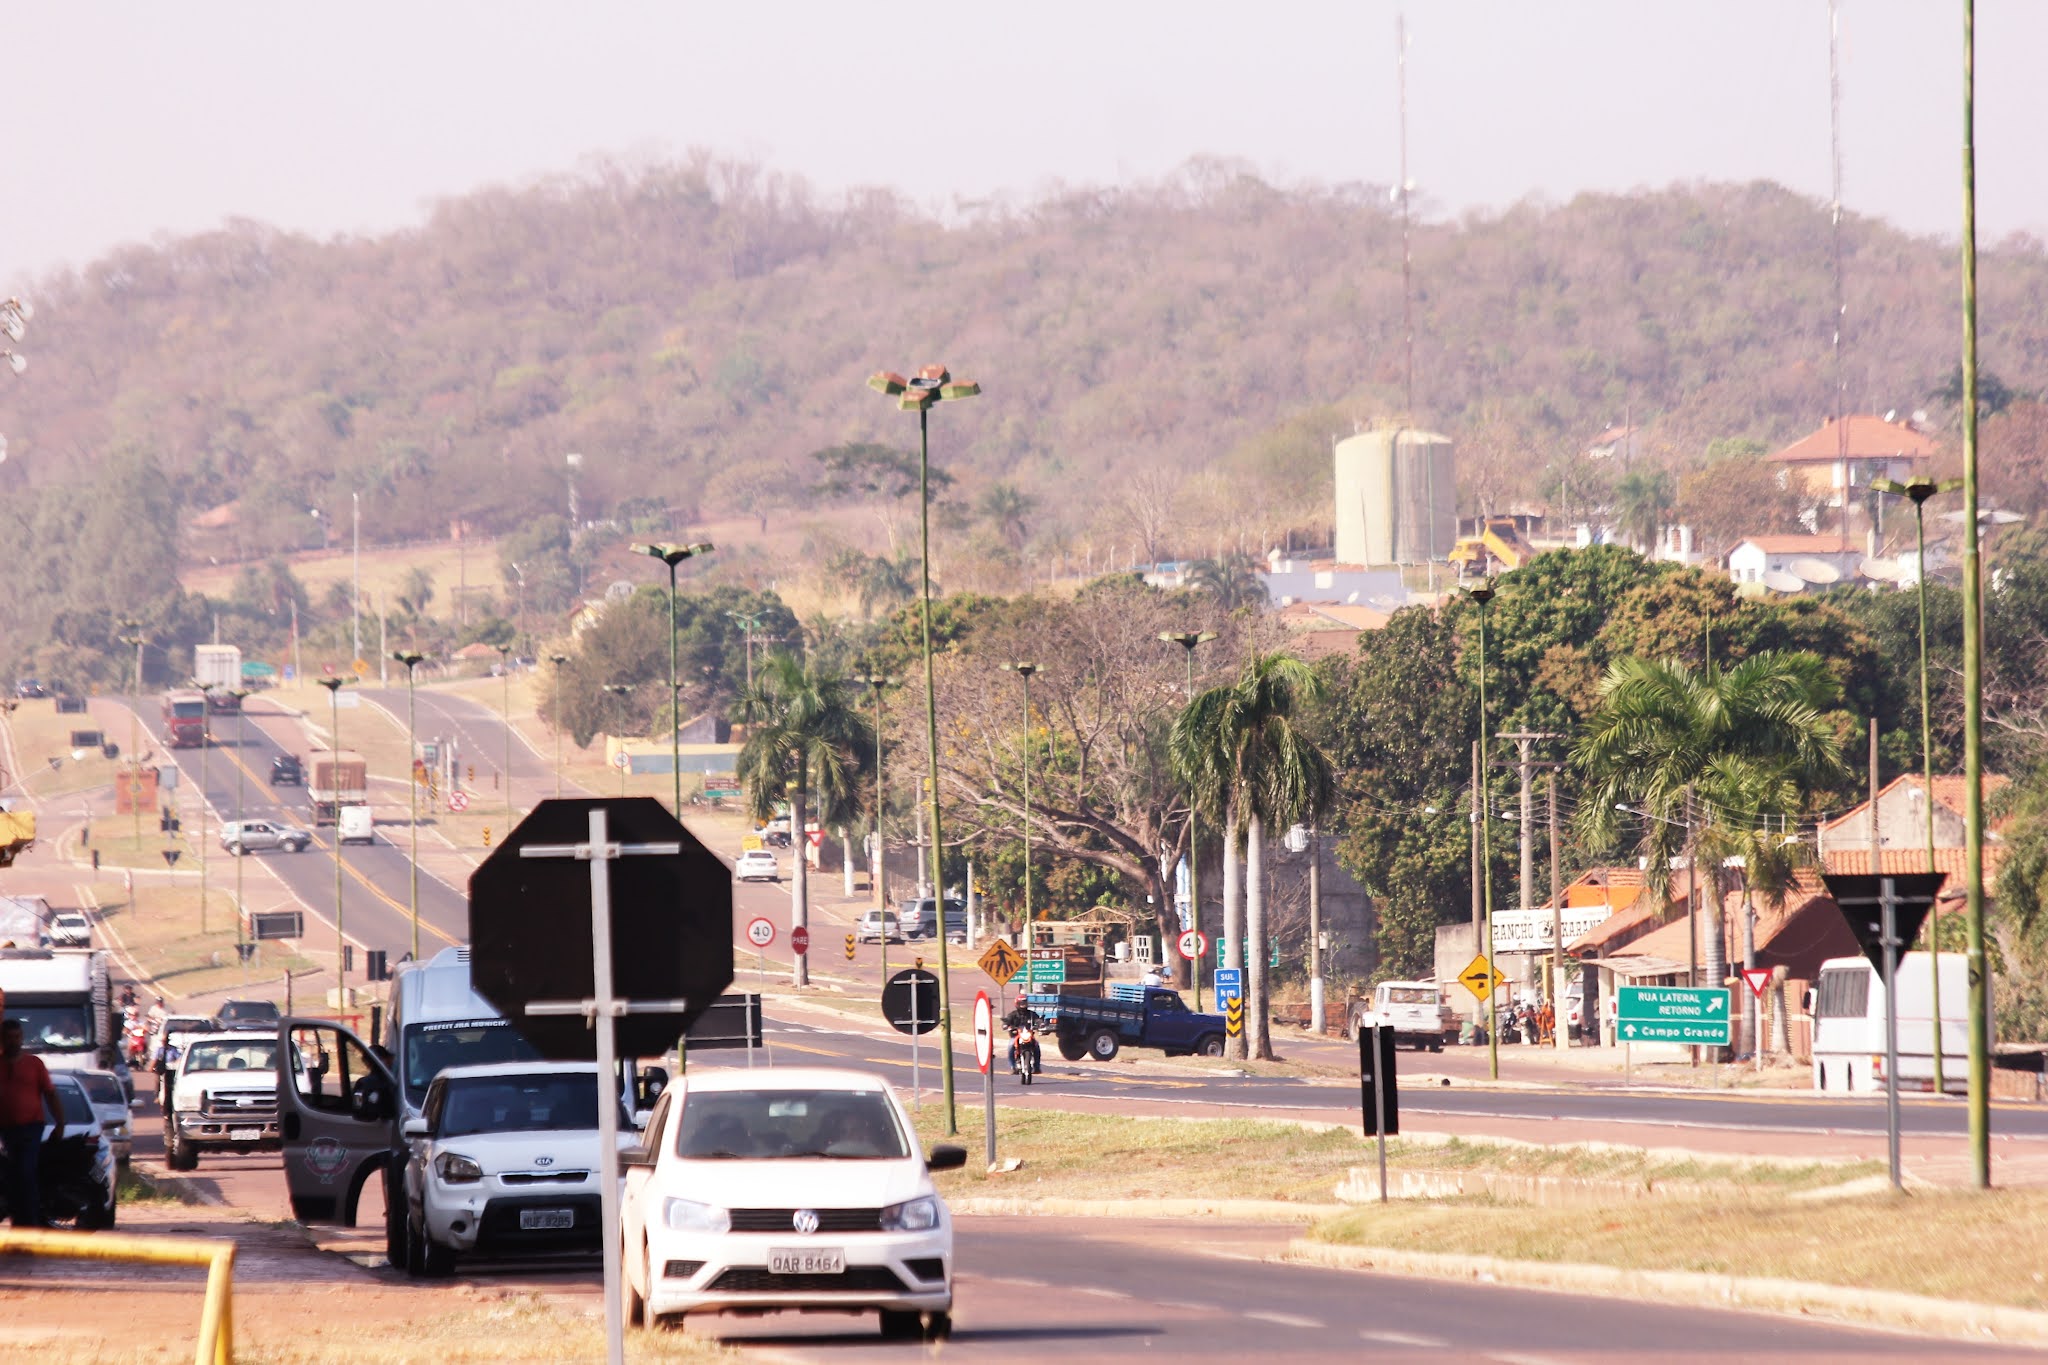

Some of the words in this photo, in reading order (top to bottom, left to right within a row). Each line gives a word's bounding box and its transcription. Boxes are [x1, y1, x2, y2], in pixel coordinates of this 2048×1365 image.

[753, 926, 770, 937] 40
[1491, 922, 1535, 941] RANCHO
[792, 936, 808, 945] PARE
[1034, 973, 1060, 981] Grande
[1220, 973, 1235, 981] SUL
[1220, 988, 1236, 997] km
[1637, 991, 1658, 1003] RUA
[1660, 992, 1701, 1004] LATERAL
[1658, 1005, 1702, 1017] RETORNO
[1641, 1025, 1681, 1038] Campo
[1683, 1027, 1725, 1039] Grande
